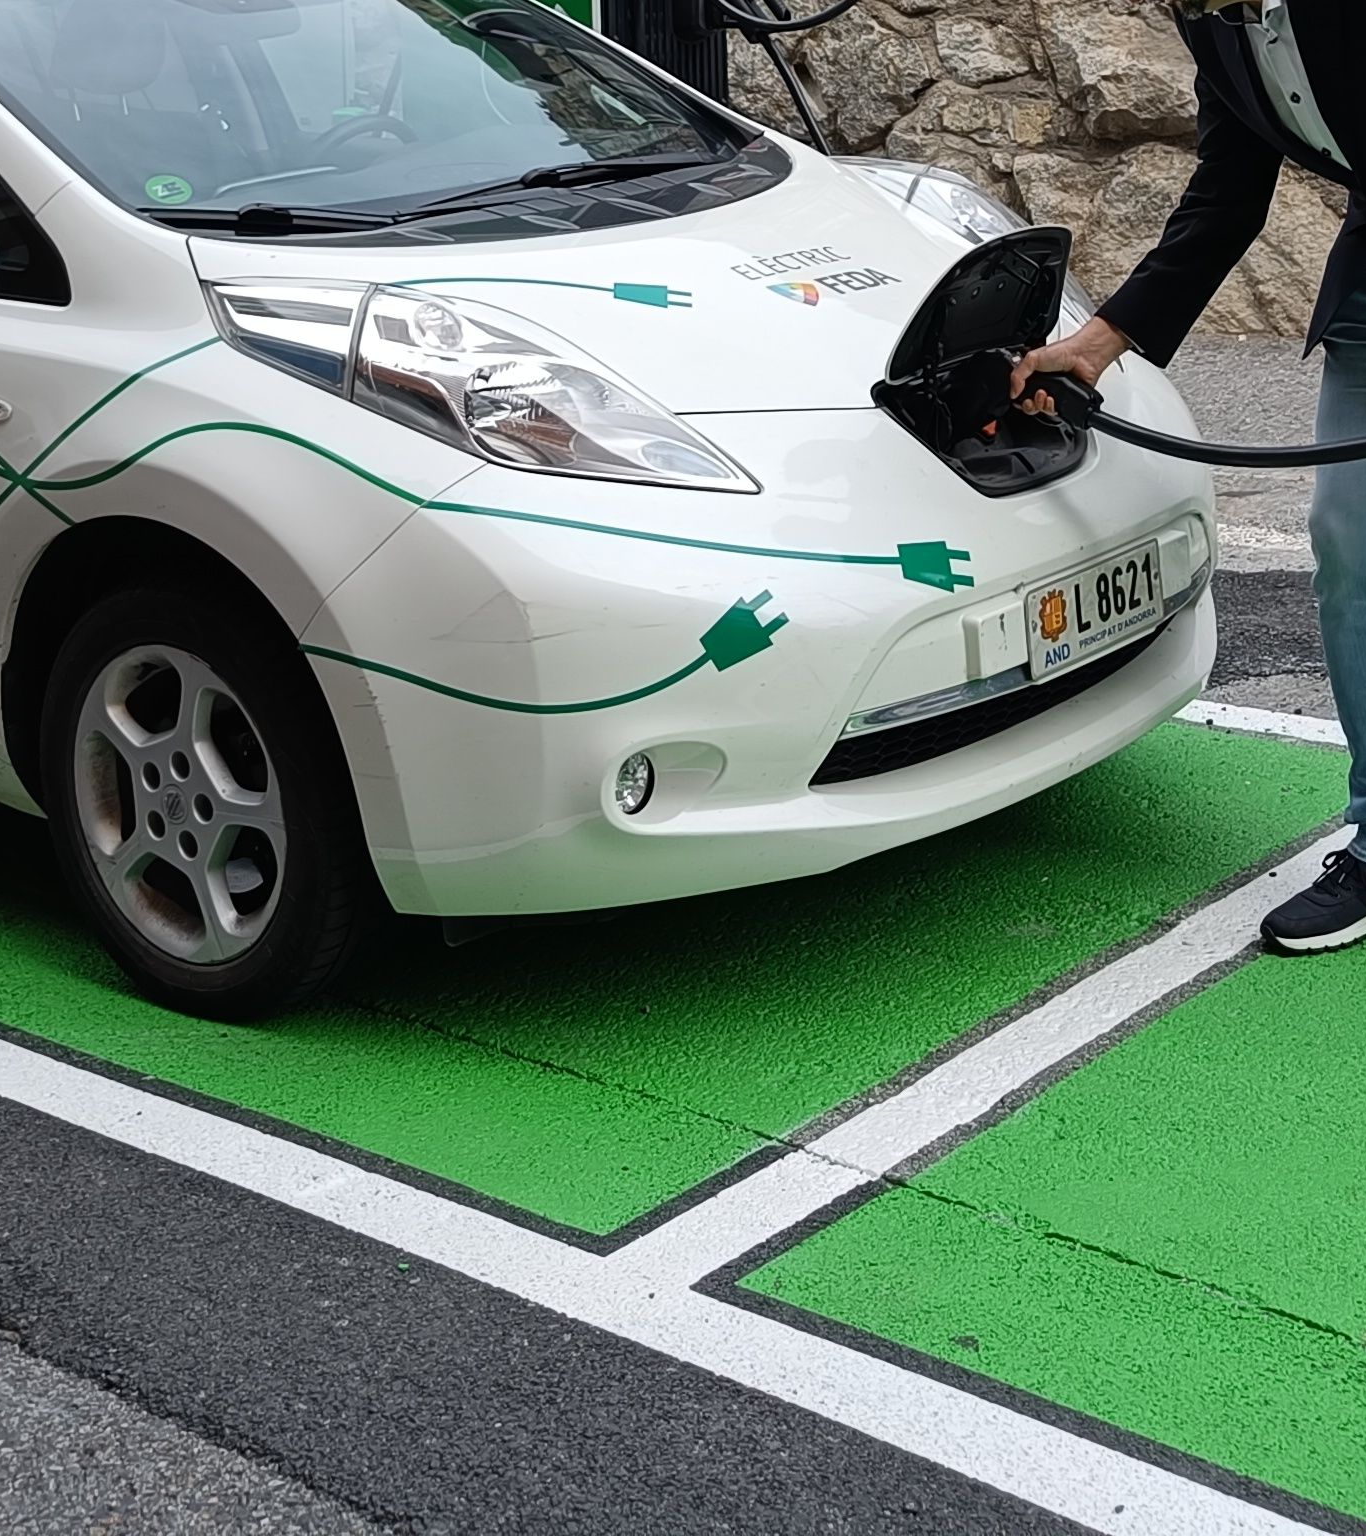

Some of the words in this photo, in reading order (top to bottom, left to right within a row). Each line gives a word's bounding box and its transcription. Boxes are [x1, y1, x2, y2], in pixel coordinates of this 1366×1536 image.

[730, 246, 852, 281] ELÈCTRIC
[813, 267, 903, 295] FEDA
[1074, 583, 1092, 634] L
[1096, 552, 1154, 623] 8621
[1078, 625, 1117, 650] PRINCIPAT
[1044, 643, 1071, 668] AND
